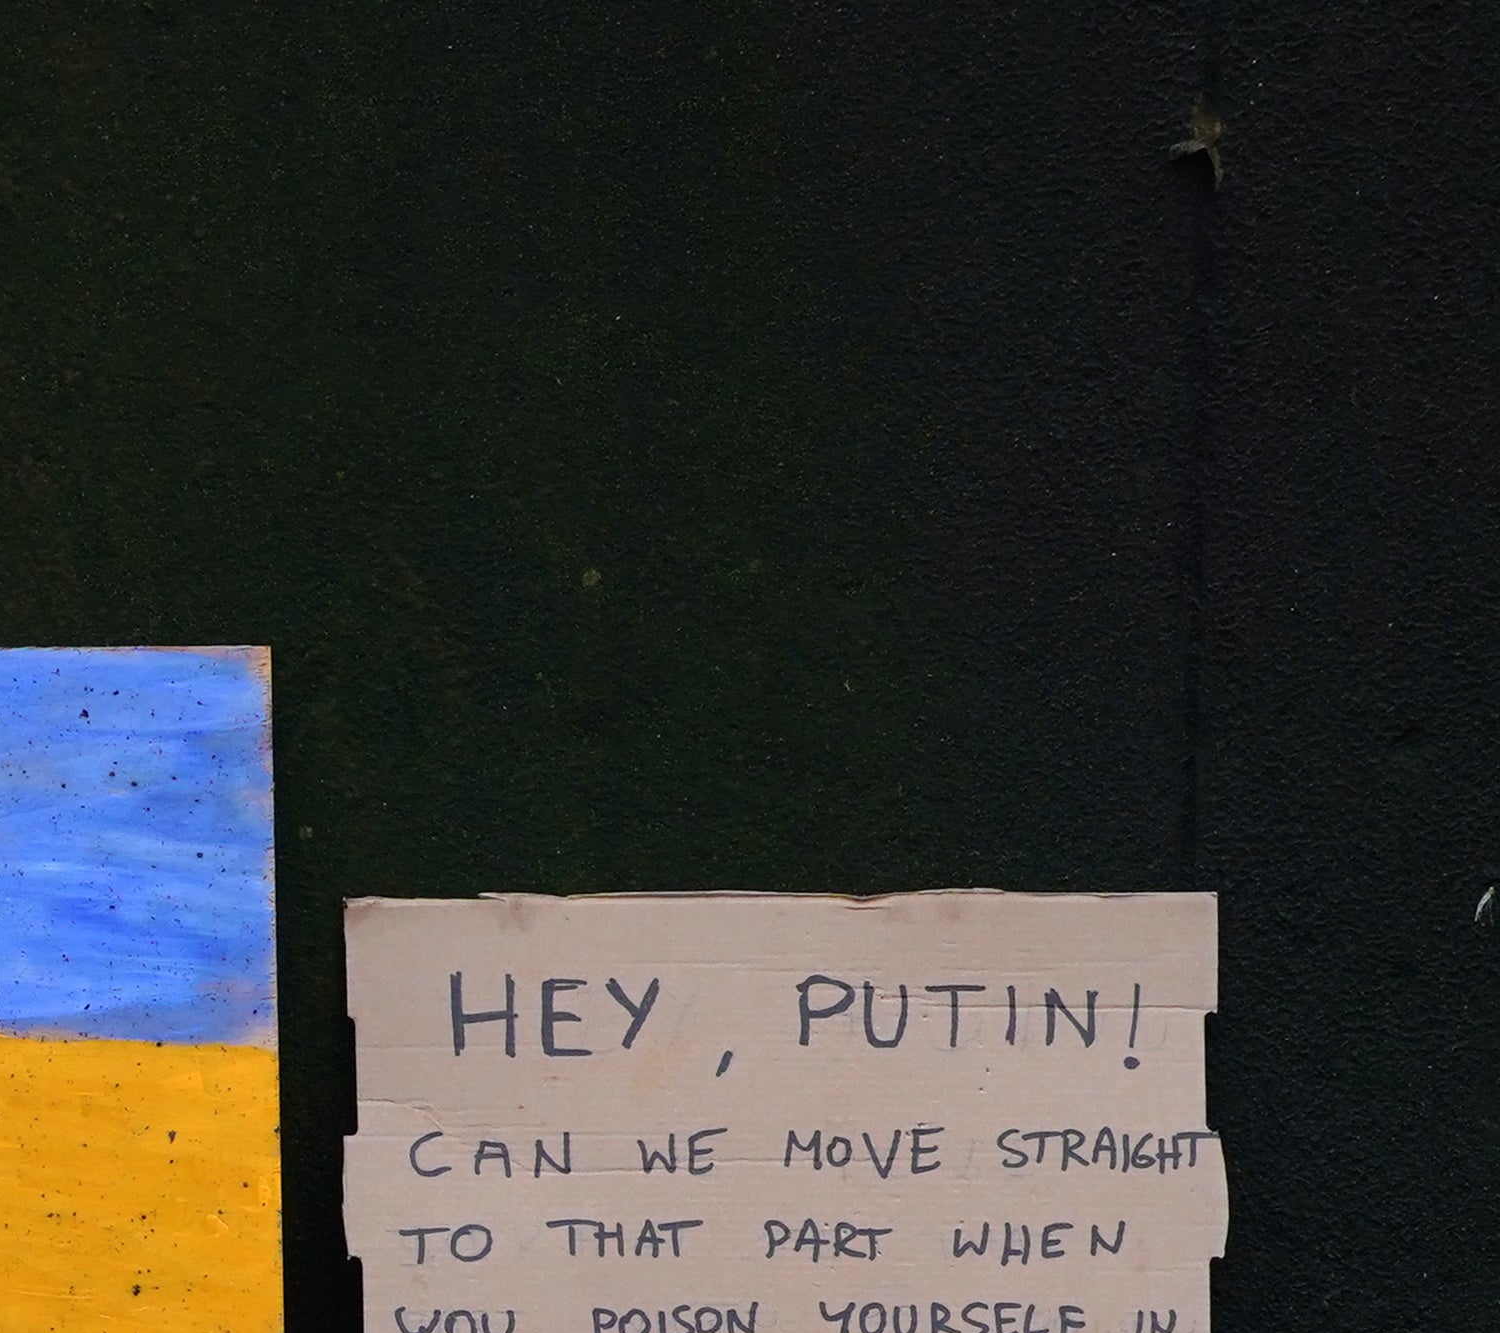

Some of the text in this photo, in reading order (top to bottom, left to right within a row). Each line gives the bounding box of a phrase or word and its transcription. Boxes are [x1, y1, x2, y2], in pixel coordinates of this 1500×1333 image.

[795, 974, 1141, 1070] PUTIN!
[409, 1126, 1218, 1179] CAN WE MOVE STRAIGHT
[398, 1219, 1126, 1265] TO THAT PART WHEN
